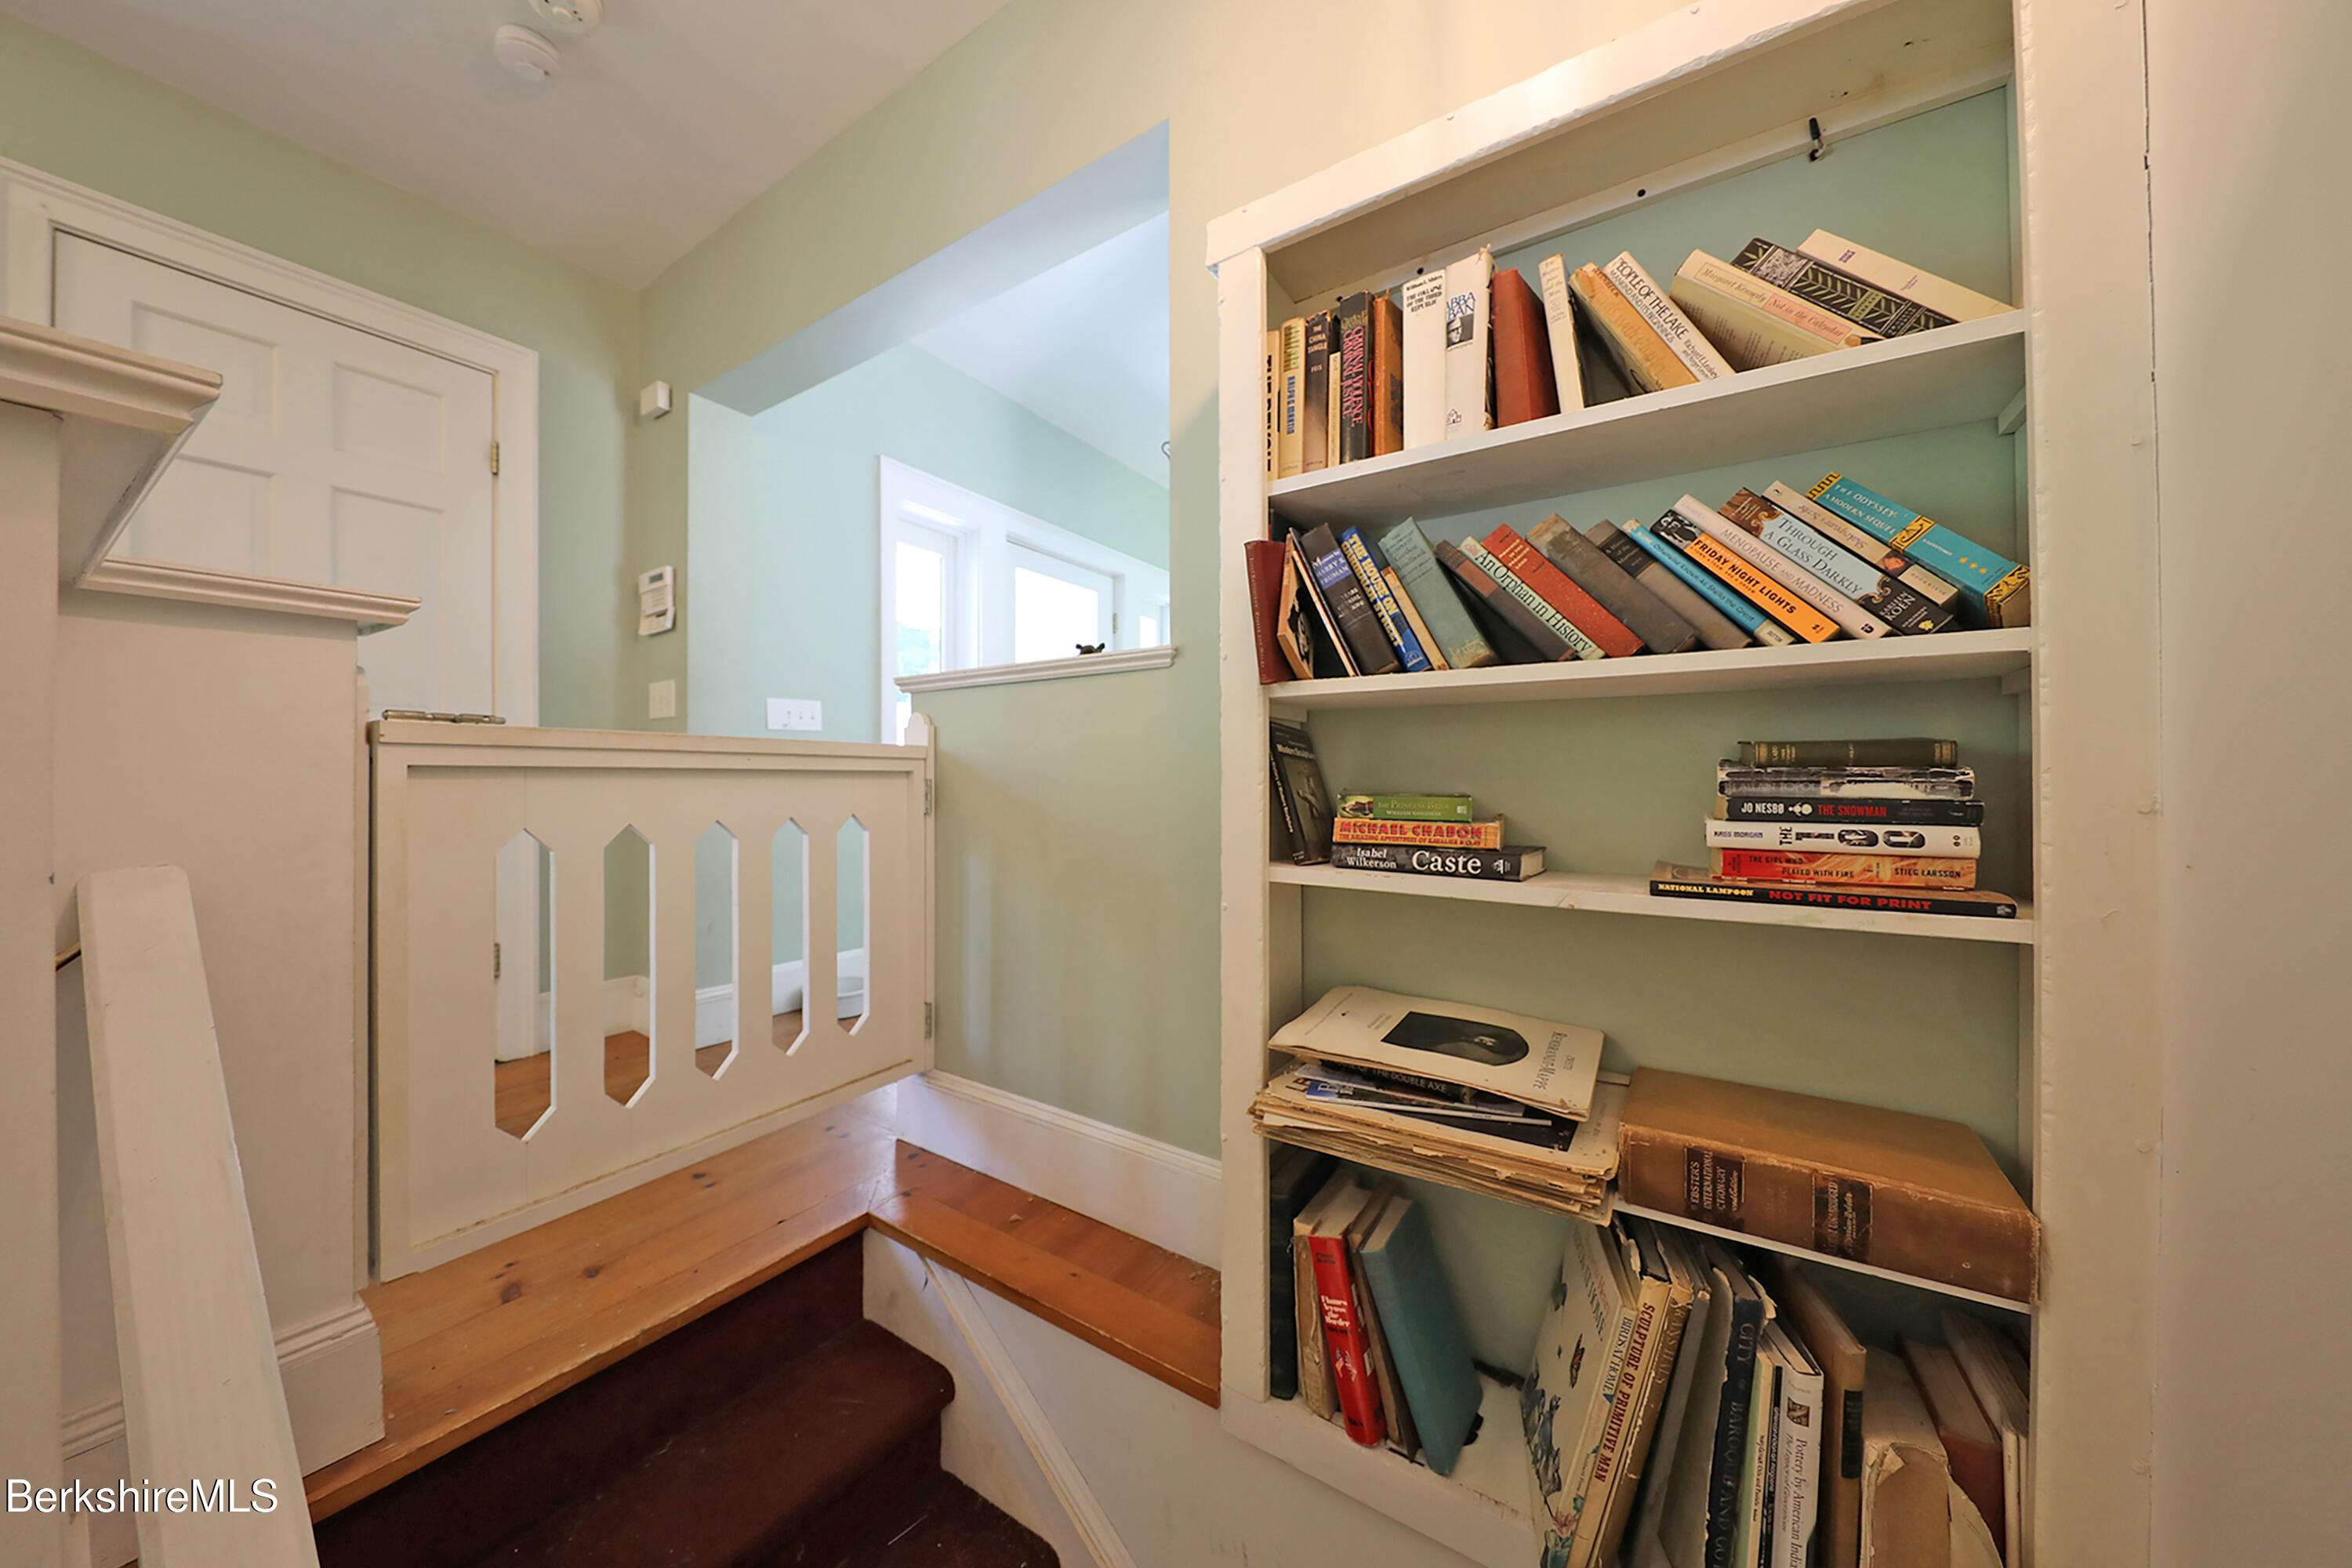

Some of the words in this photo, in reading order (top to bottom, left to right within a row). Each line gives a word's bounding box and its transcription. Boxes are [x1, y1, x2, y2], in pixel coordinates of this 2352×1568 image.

[1701, 267, 1737, 292] Margaret
[1637, 283, 1655, 301] OF
[1648, 292, 1671, 319] THE
[1663, 310, 1690, 340] LAKE
[1352, 325, 1364, 376] CRIMINAL
[1831, 496, 1865, 520] MODERN
[1777, 517, 1838, 561] THROUGH
[1319, 565, 1348, 586] TRUMAN
[1348, 532, 1367, 561] THE
[1361, 558, 1386, 597] HOUSE
[1383, 597, 1399, 615] ON
[1722, 528, 1782, 572] MENOPAUSE
[1793, 577, 1843, 613] MADNESS
[1764, 530, 1773, 540] A
[1777, 535, 1813, 562] GLASS
[1811, 560, 1864, 594] DARKLY
[1653, 542, 1680, 564] Otherwise
[1680, 561, 1700, 581] Known
[1707, 581, 1726, 601] Sheila
[1735, 603, 1755, 622] Great
[1693, 539, 1730, 565] FRIDAY
[1728, 563, 1761, 586] NIGHT
[1759, 586, 1797, 615] LIGHTS
[1475, 550, 1496, 570] An
[1493, 563, 1537, 608] Orphan
[1532, 598, 1550, 618] in
[1545, 609, 1593, 654] History
[1884, 593, 1916, 621] KOEN
[1373, 601, 1404, 648] STREET
[1741, 802, 1753, 813] JO
[1817, 804, 1835, 815] THE
[1837, 804, 1887, 817] SNOWMAN
[1339, 821, 1409, 836] MICHAEL
[1412, 825, 1483, 839] CHABON
[1733, 830, 1763, 839] MORGAN
[1779, 826, 1793, 846] THE
[1346, 855, 1397, 869] Wilkerson
[1356, 848, 1387, 858] Isabel
[1412, 850, 1482, 874] Caste
[1781, 867, 1811, 877] PLAYED
[1813, 869, 1834, 877] WITH
[1835, 869, 1855, 879] FIRE
[1894, 867, 1918, 877] STIEG
[1921, 868, 1962, 879] LARSSON
[1657, 883, 1704, 894] NATIONAL
[1706, 886, 1754, 897] LAMPOON
[1769, 890, 1804, 902] NOT
[1808, 891, 1833, 902] FIT
[1837, 895, 1872, 906] FOR
[1877, 897, 1932, 910] PRINT
[1373, 1069, 1389, 1078] THE
[1391, 1073, 1426, 1088] DOUBLE
[1428, 1081, 1447, 1094] AXE
[1615, 1316, 1633, 1352] BIRDS
[1627, 1301, 1656, 1371] SCULPTURE
[1736, 1322, 1755, 1367] CITY
[1602, 1361, 1621, 1393] HOME
[1621, 1371, 1636, 1389] OF
[1604, 1387, 1632, 1459] PRIMITIVE
[1722, 1400, 1745, 1489] BAROQUE
[1792, 1438, 1808, 1471] Pottery
[1593, 1456, 1614, 1483] MAN
[1791, 1476, 1806, 1491] by
[1715, 1490, 1739, 1530] AND
[1790, 1490, 1806, 1540] American
